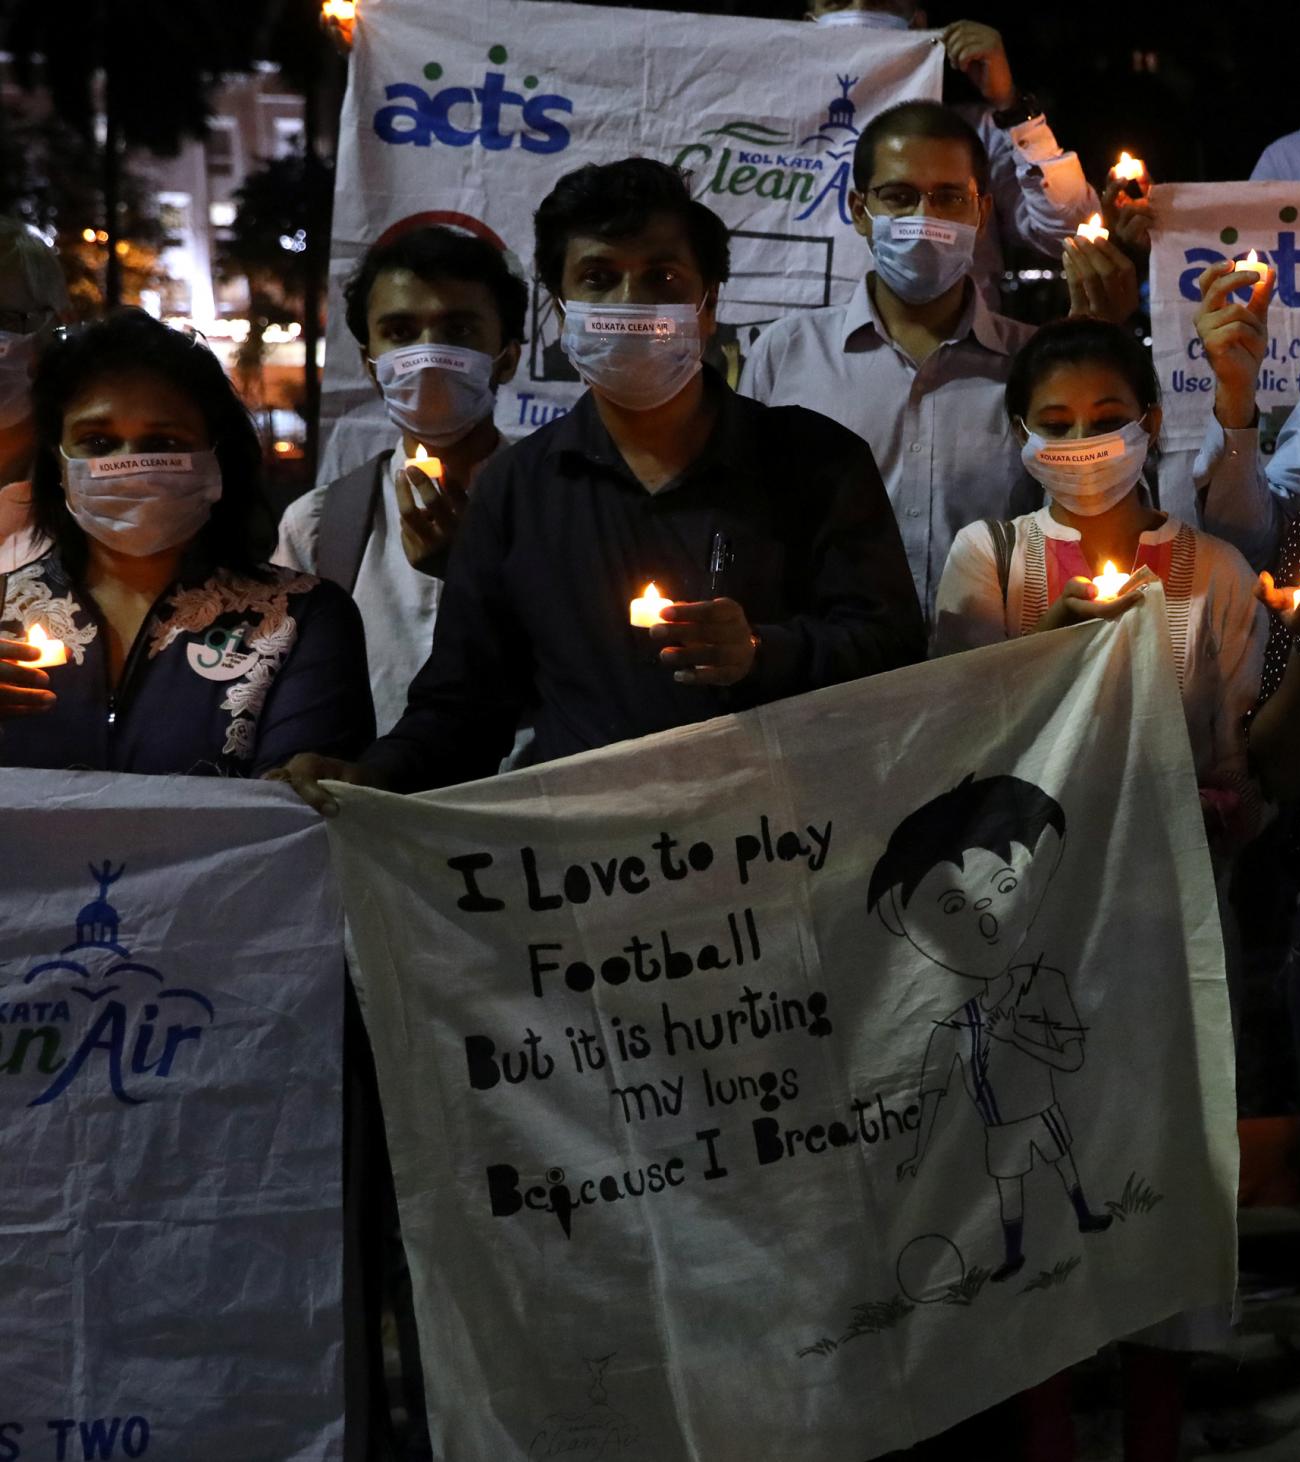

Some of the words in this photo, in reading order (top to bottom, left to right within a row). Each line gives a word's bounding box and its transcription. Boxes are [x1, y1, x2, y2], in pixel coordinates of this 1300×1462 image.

[373, 73, 573, 154] acts
[672, 143, 813, 203] Clean
[738, 151, 823, 171] KOLKATA
[592, 322, 625, 331] KOLKATA
[628, 323, 654, 331] CLEAN
[401, 357, 429, 368] KOLKATA
[430, 356, 453, 366] CLEAN
[454, 360, 465, 368] AIR
[1172, 371, 1212, 392] Use
[99, 459, 138, 471] KOLKATA
[140, 459, 168, 467] CLEAN
[169, 458, 183, 467] AIR
[1039, 453, 1071, 461] KOLKATA
[1072, 454, 1095, 462] CLEAN
[1096, 450, 1109, 458] AIR
[447, 853, 505, 912] I
[521, 846, 650, 911] Love
[653, 831, 714, 880] to
[735, 815, 832, 884] play
[528, 908, 761, 997] Football
[27, 1001, 203, 1107] Air
[465, 1028, 554, 1090] But
[567, 1027, 605, 1072] it
[612, 1016, 651, 1062] is
[662, 986, 833, 1056] hurting
[611, 1075, 684, 1123] my
[702, 1067, 799, 1112] lungs
[696, 1128, 727, 1181] I
[752, 1092, 922, 1166] Breathe
[47, 1416, 150, 1462] TWO
